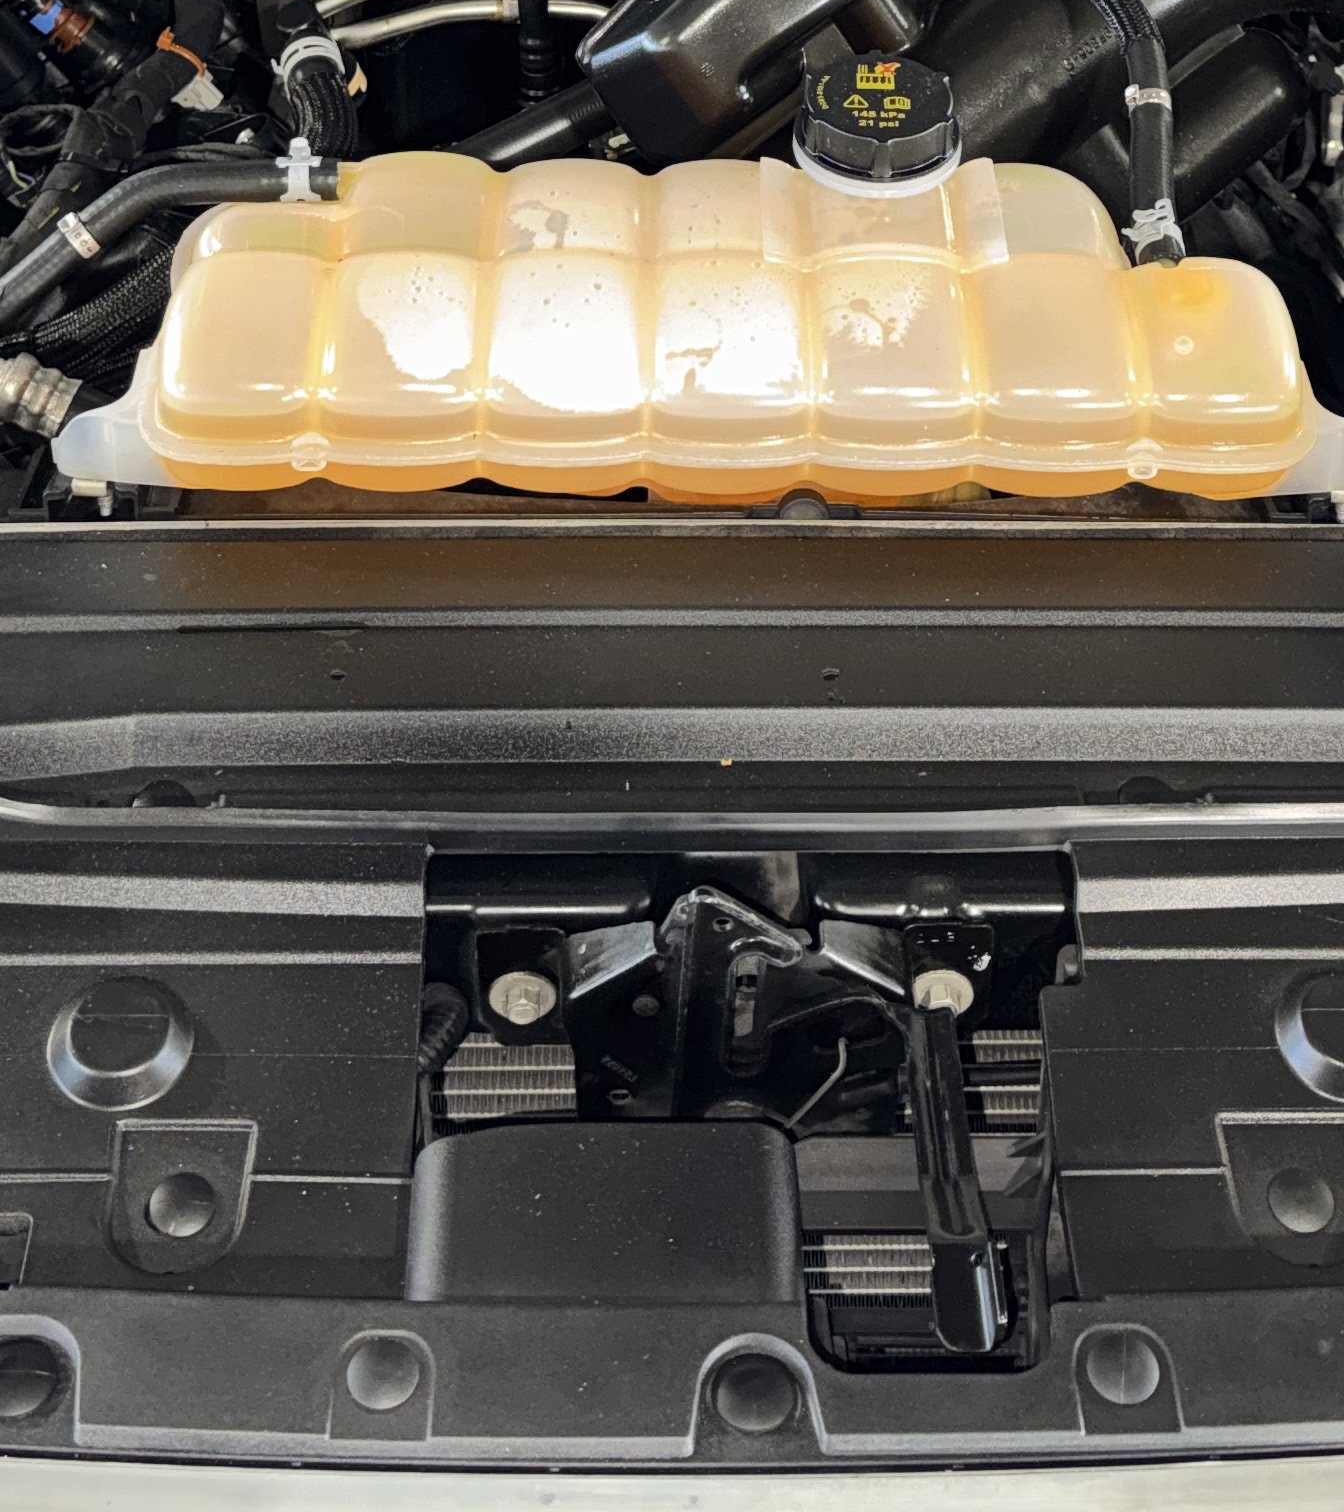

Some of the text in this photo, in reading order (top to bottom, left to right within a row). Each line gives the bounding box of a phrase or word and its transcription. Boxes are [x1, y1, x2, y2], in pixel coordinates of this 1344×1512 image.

[852, 110, 906, 119] 145 kPa
[858, 119, 900, 128] 21 psi
